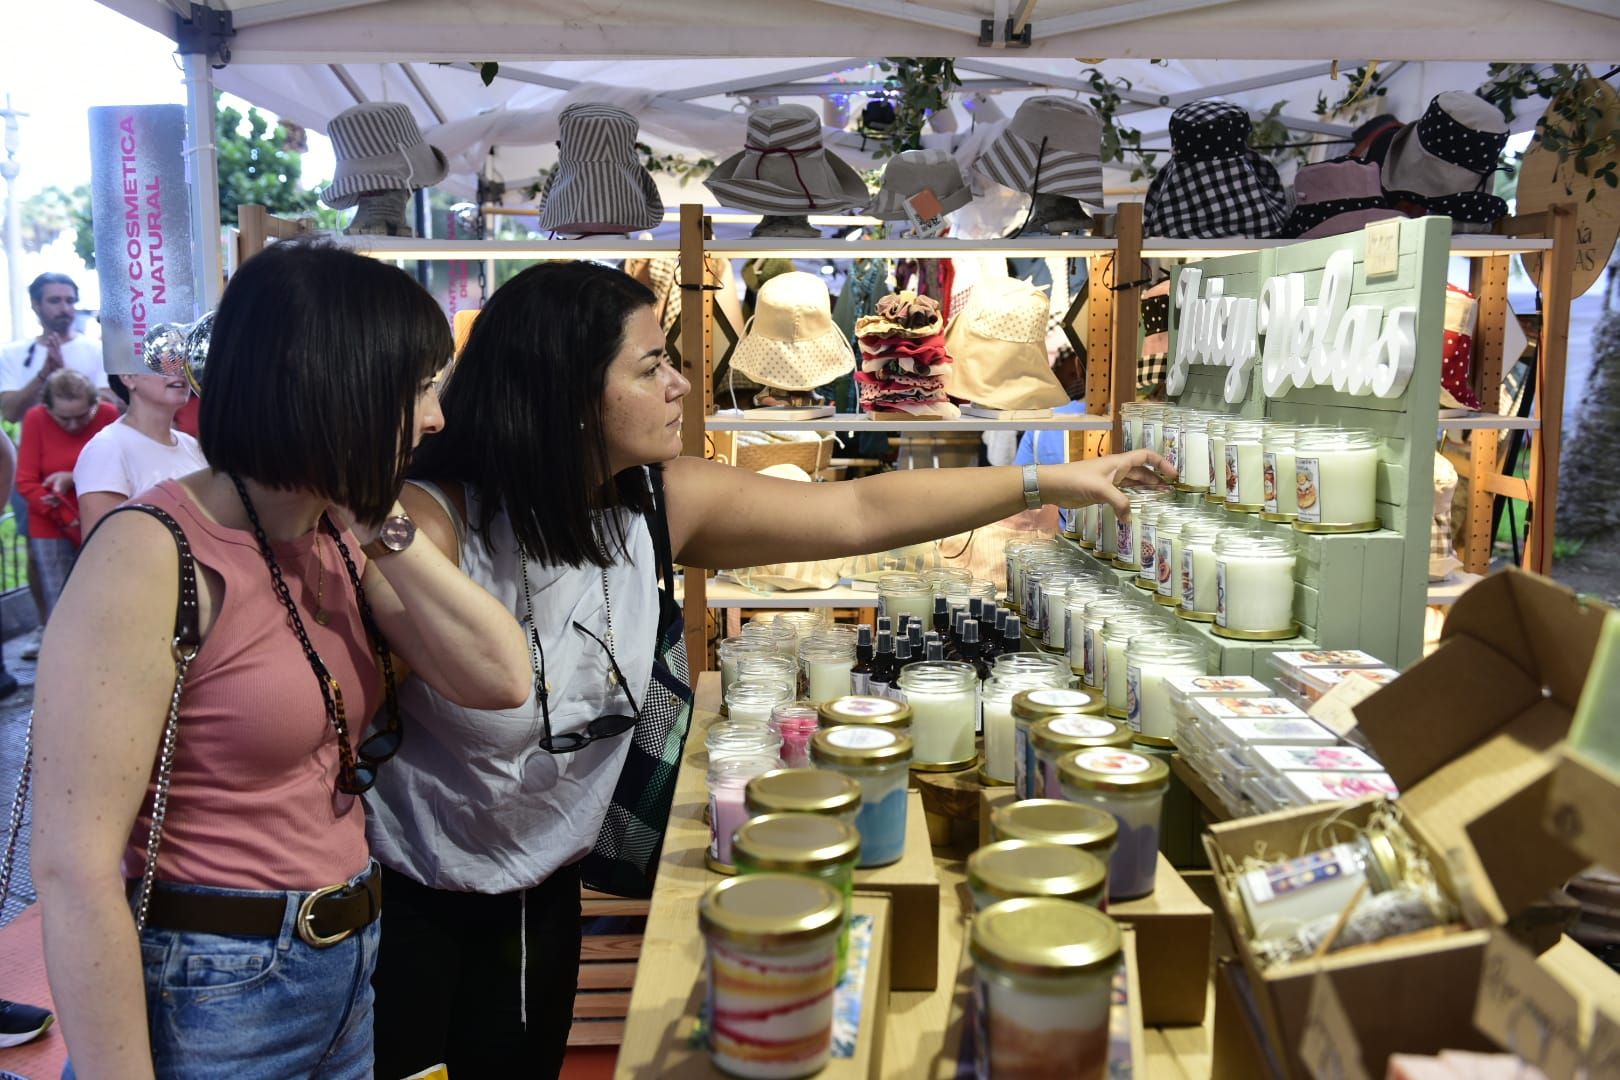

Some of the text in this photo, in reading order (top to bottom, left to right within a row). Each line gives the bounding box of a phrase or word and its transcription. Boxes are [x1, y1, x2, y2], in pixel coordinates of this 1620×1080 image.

[119, 115, 143, 280] COSMETICA
[145, 175, 166, 304] NATURAL
[1166, 249, 1417, 403] Juicy Velas
